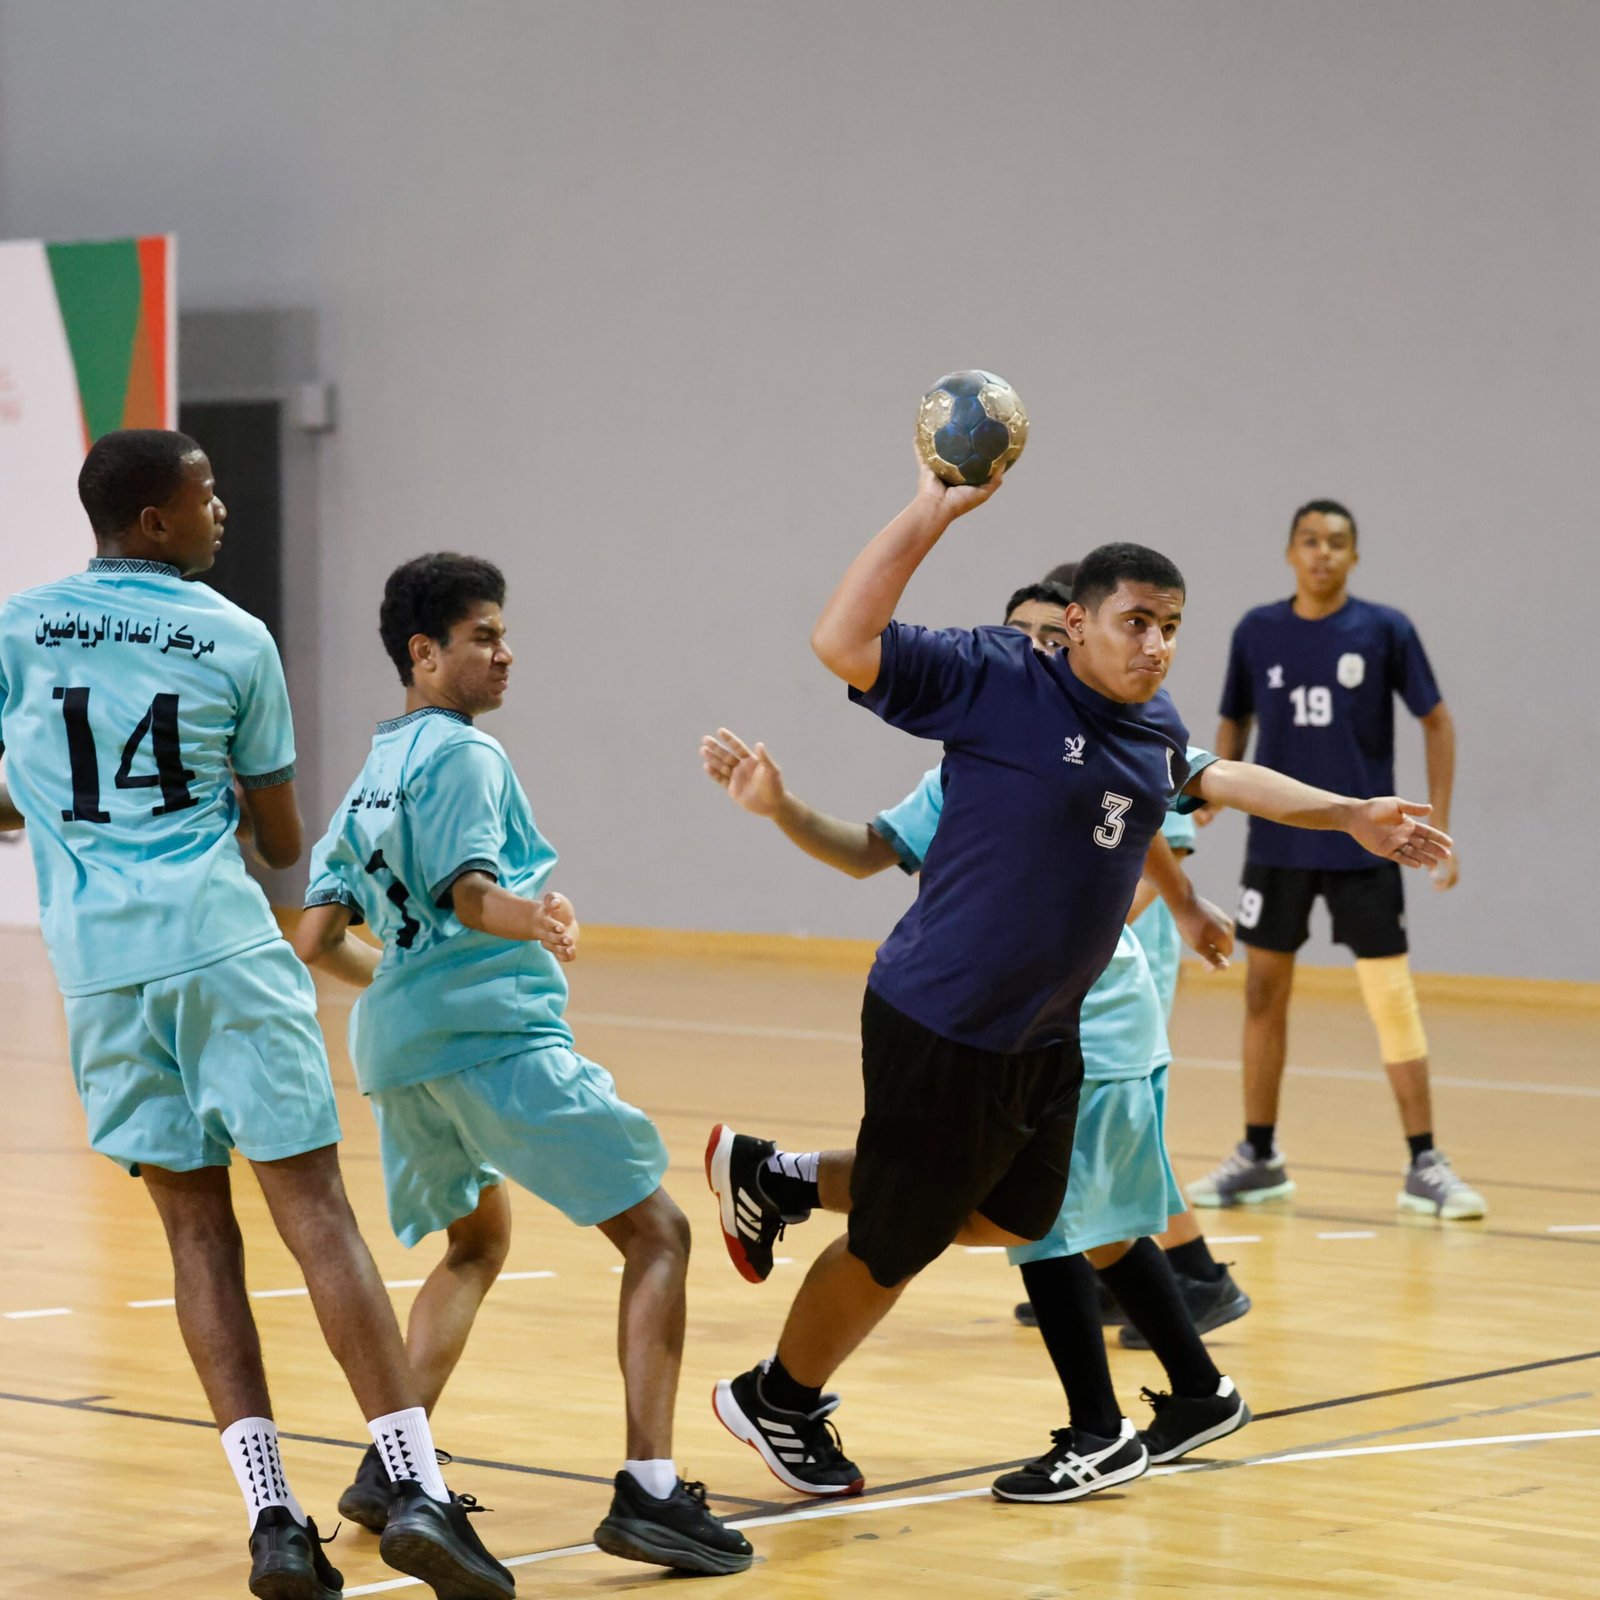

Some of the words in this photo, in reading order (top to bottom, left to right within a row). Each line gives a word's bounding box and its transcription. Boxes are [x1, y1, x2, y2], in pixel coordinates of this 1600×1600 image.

[35, 611, 111, 649] الرياضيين
[161, 622, 215, 660] مركز
[1289, 685, 1333, 727] 19
[52, 686, 200, 824] 14
[1093, 790, 1133, 849] 3
[1238, 887, 1264, 929] 9
